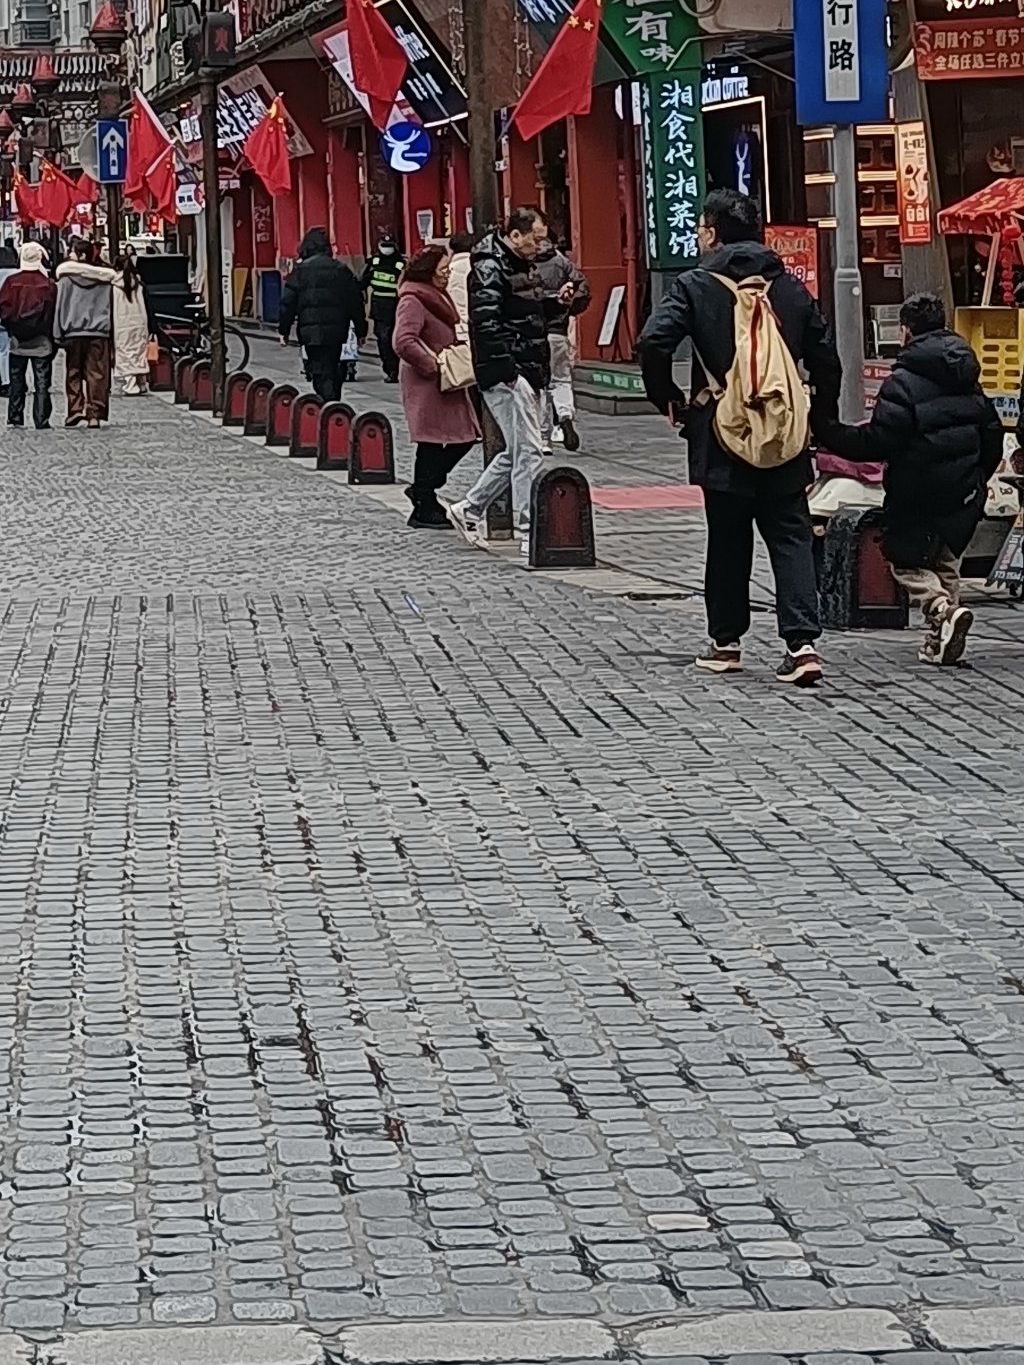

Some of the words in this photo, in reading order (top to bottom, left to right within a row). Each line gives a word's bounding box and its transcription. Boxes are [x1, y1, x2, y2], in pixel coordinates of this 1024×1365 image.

[660, 80, 698, 259] 湘食代湘菜馆
